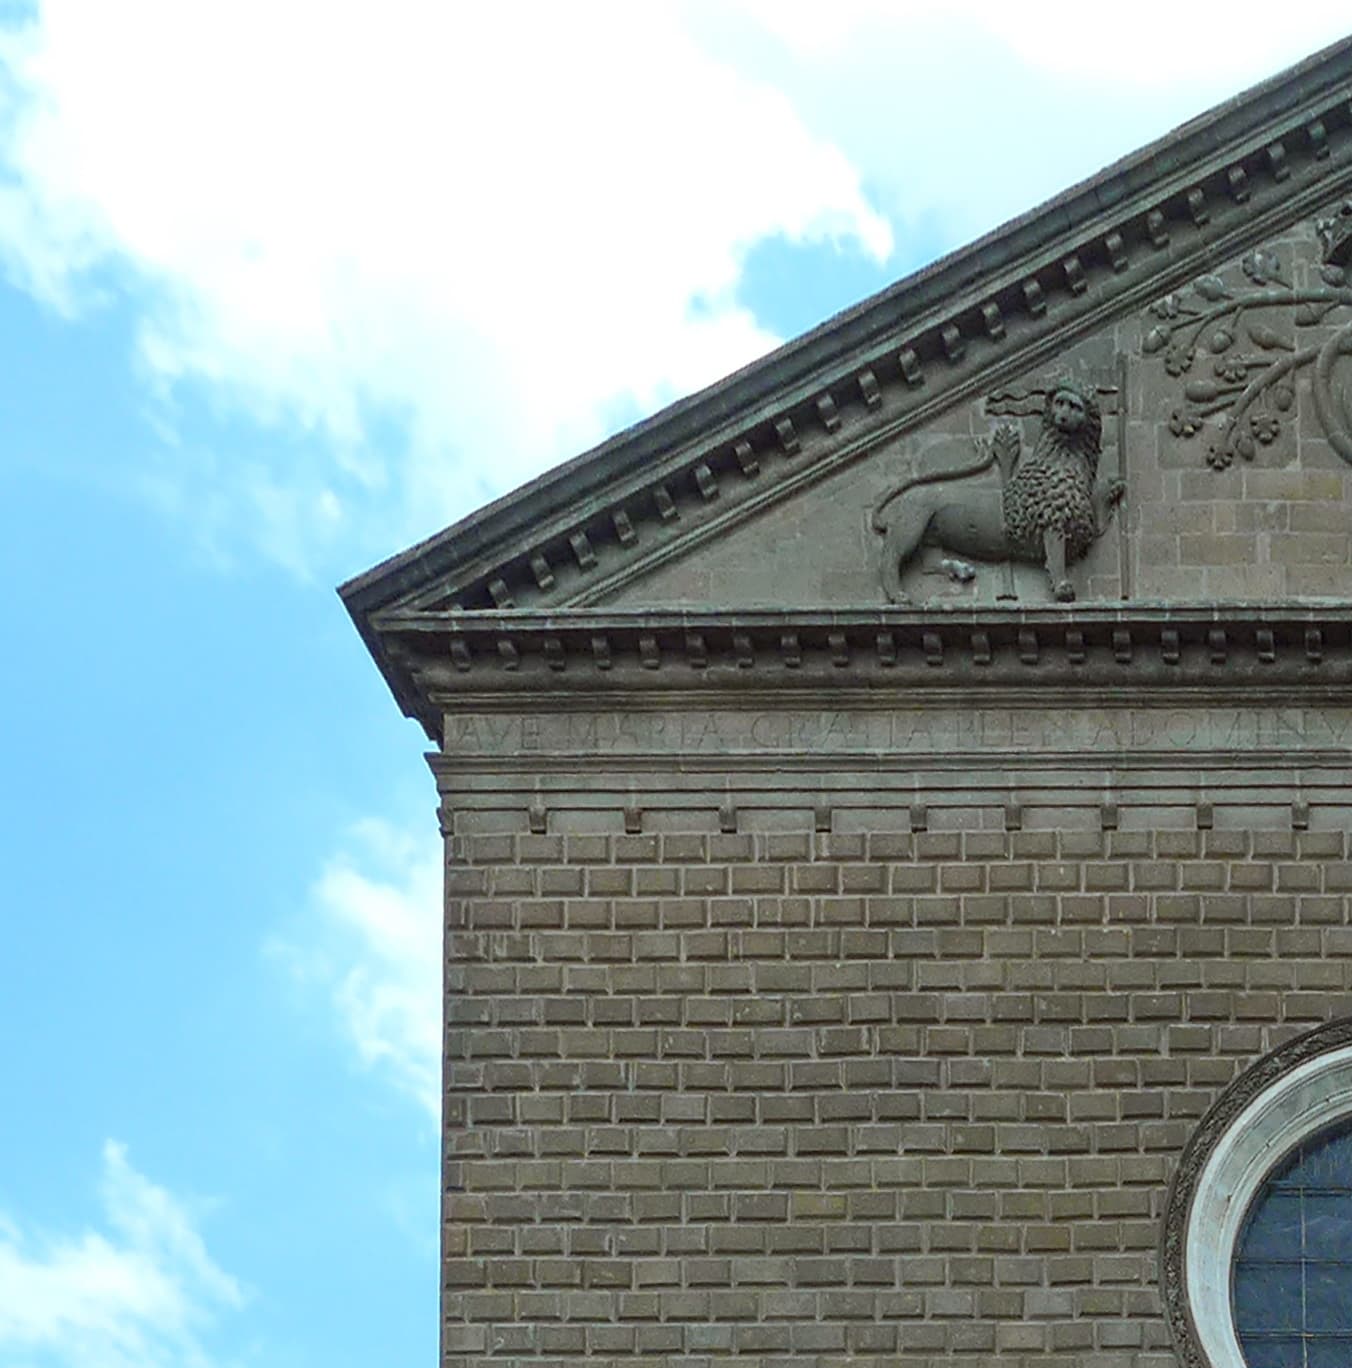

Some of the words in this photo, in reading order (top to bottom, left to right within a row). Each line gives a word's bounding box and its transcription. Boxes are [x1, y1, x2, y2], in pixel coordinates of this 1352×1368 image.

[456, 716, 541, 749] AVE
[566, 714, 727, 748] MARIA
[751, 714, 936, 748] GRATIA
[956, 711, 1126, 748] PLENA
